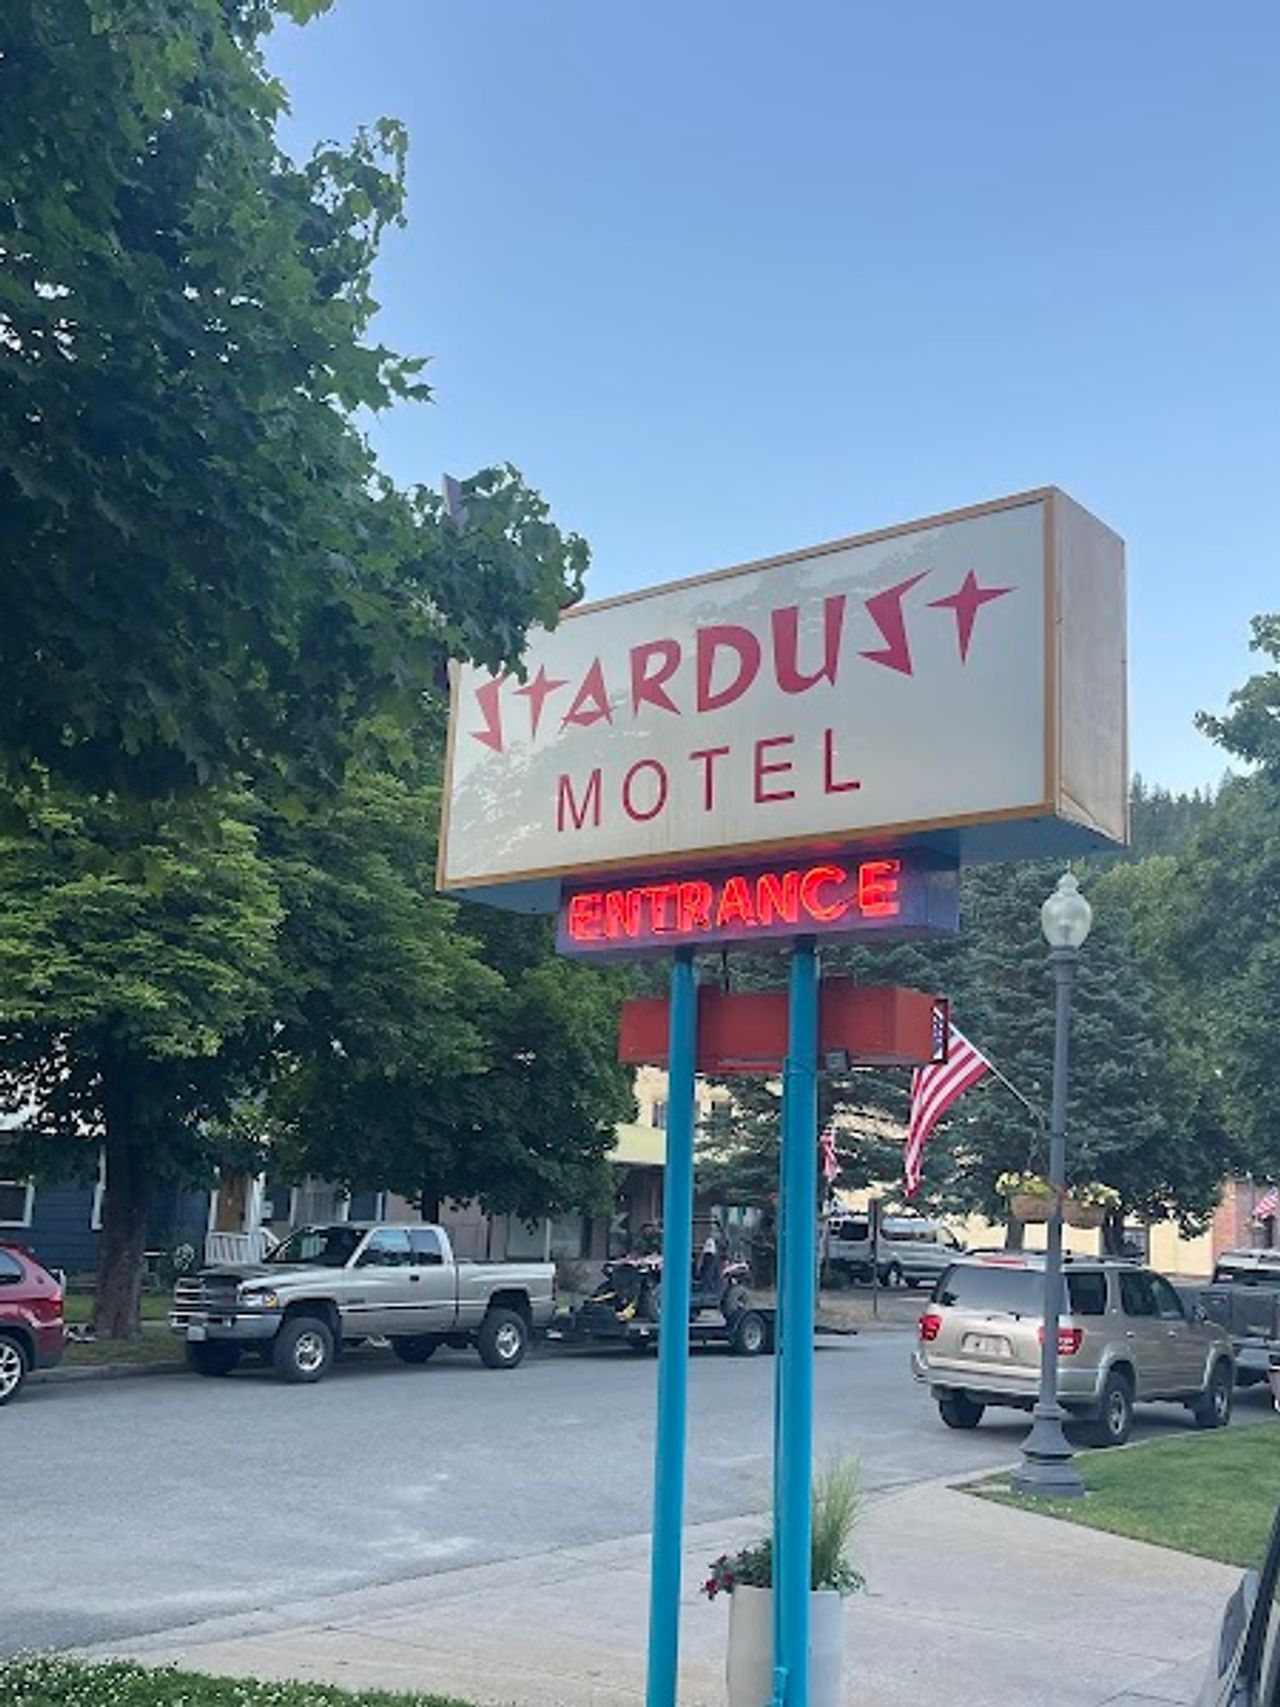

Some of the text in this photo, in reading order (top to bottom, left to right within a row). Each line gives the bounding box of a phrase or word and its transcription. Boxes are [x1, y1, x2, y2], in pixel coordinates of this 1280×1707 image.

[469, 568, 1014, 752] STARDUST
[557, 728, 861, 832] MOTEL
[569, 859, 902, 942] ENTRANCE
